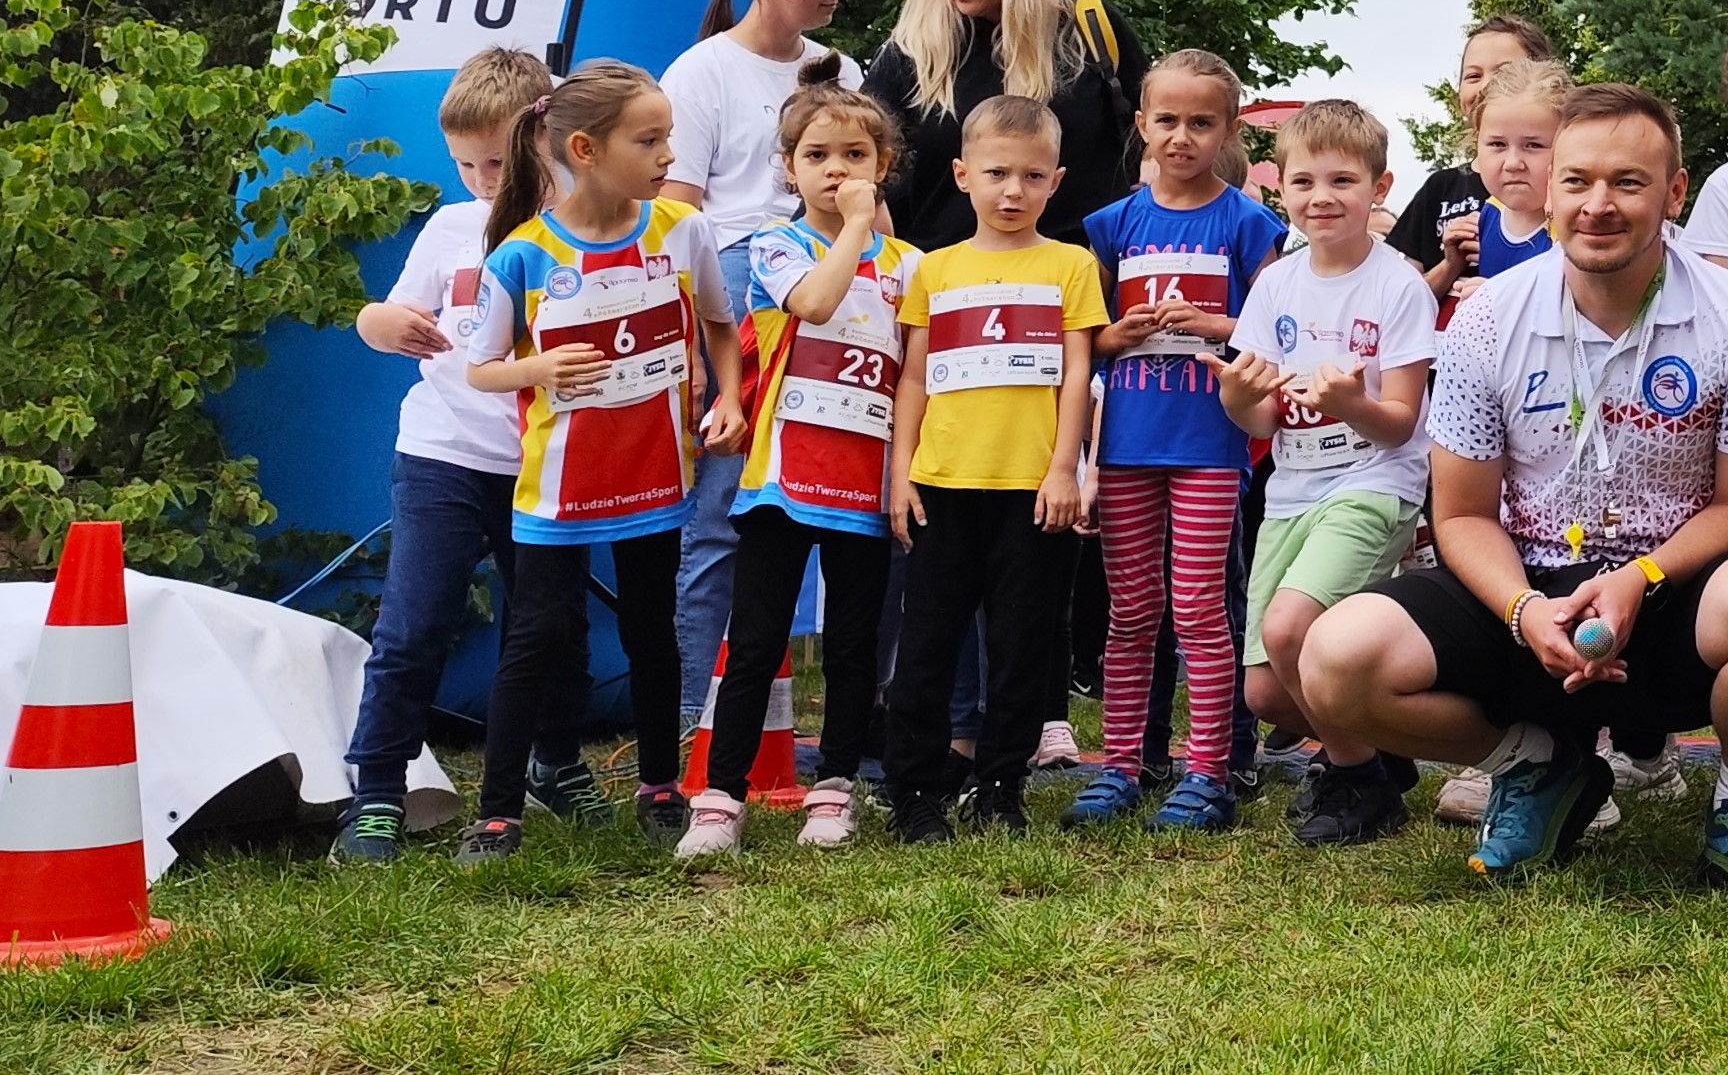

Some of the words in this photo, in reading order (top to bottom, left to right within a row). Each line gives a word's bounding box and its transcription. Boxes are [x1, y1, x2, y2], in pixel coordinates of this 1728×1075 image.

[1439, 196, 1479, 217] Let's
[1144, 277, 1184, 308] 16
[614, 319, 636, 354] 6
[982, 308, 1006, 340] 4
[837, 348, 884, 388] 23
